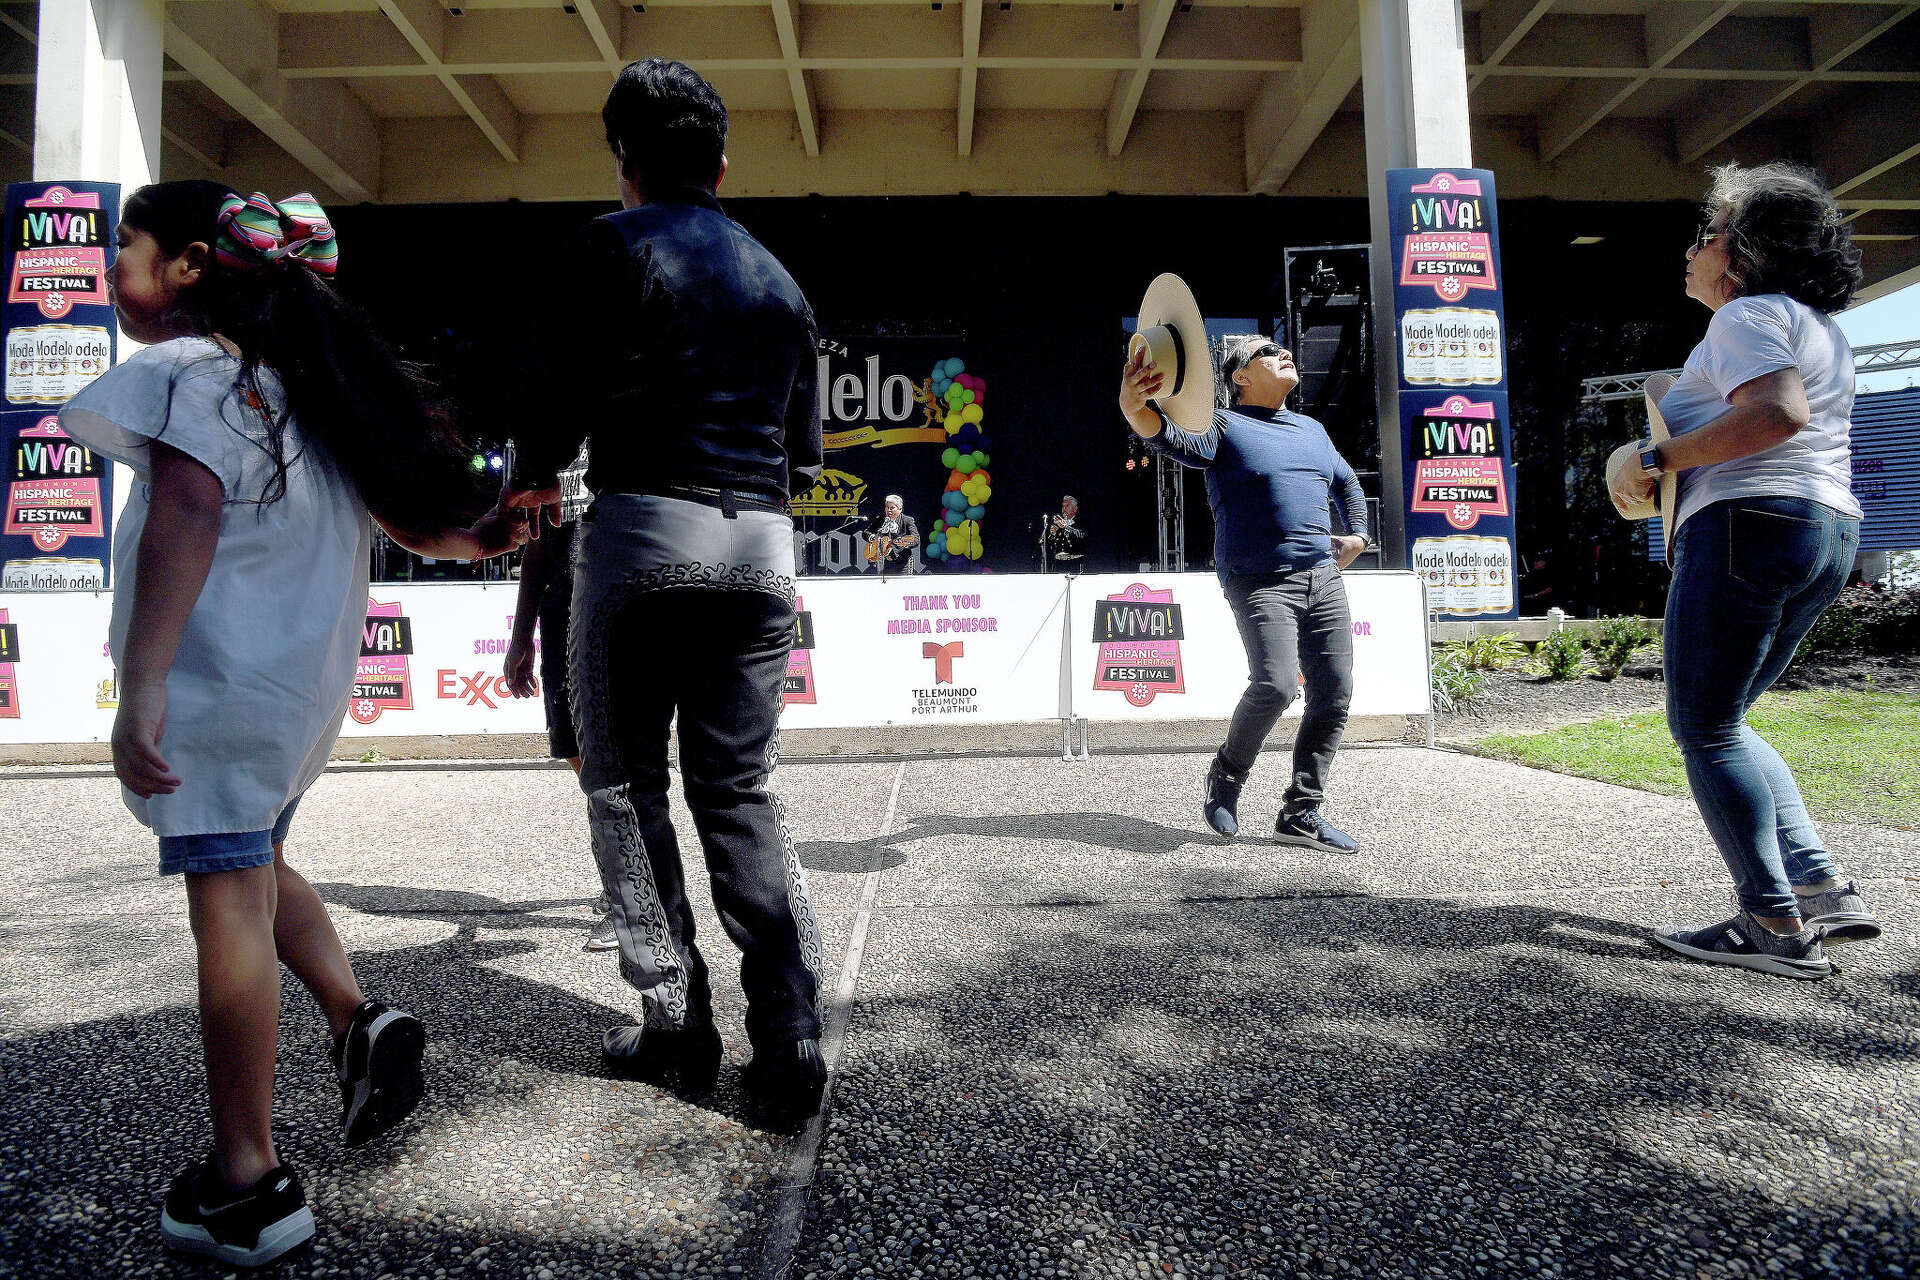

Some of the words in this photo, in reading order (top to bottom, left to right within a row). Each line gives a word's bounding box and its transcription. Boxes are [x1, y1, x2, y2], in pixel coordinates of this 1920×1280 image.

[1410, 241, 1469, 252] HISPANIC
[19, 256, 79, 268] HISPANIC
[1417, 261, 1481, 274] FESTIVAL
[53, 266, 99, 274] HERITAGE
[23, 277, 90, 290] FESTIVAL
[1435, 323, 1471, 338] Modelo
[36, 340, 73, 356] Modelo
[1422, 467, 1481, 477] HISPANIC
[14, 488, 74, 500] HISPANIC
[1428, 487, 1493, 500] FESTIVAL
[47, 498, 94, 506] HERITAGE
[18, 508, 86, 521] FESTIVAL
[1415, 553, 1444, 568] Mode
[902, 595, 949, 611] THANK
[952, 594, 981, 610] YOU
[887, 619, 931, 635] MEDIA
[936, 617, 998, 633] SPONSOR
[1104, 649, 1159, 659] HISPANIC
[1110, 668, 1170, 680] FESTIVAL
[911, 687, 977, 698] TELEMUNDO
[917, 697, 971, 706] BEAUMONT
[911, 706, 936, 715] PORT
[940, 705, 978, 714] ARTHUR
